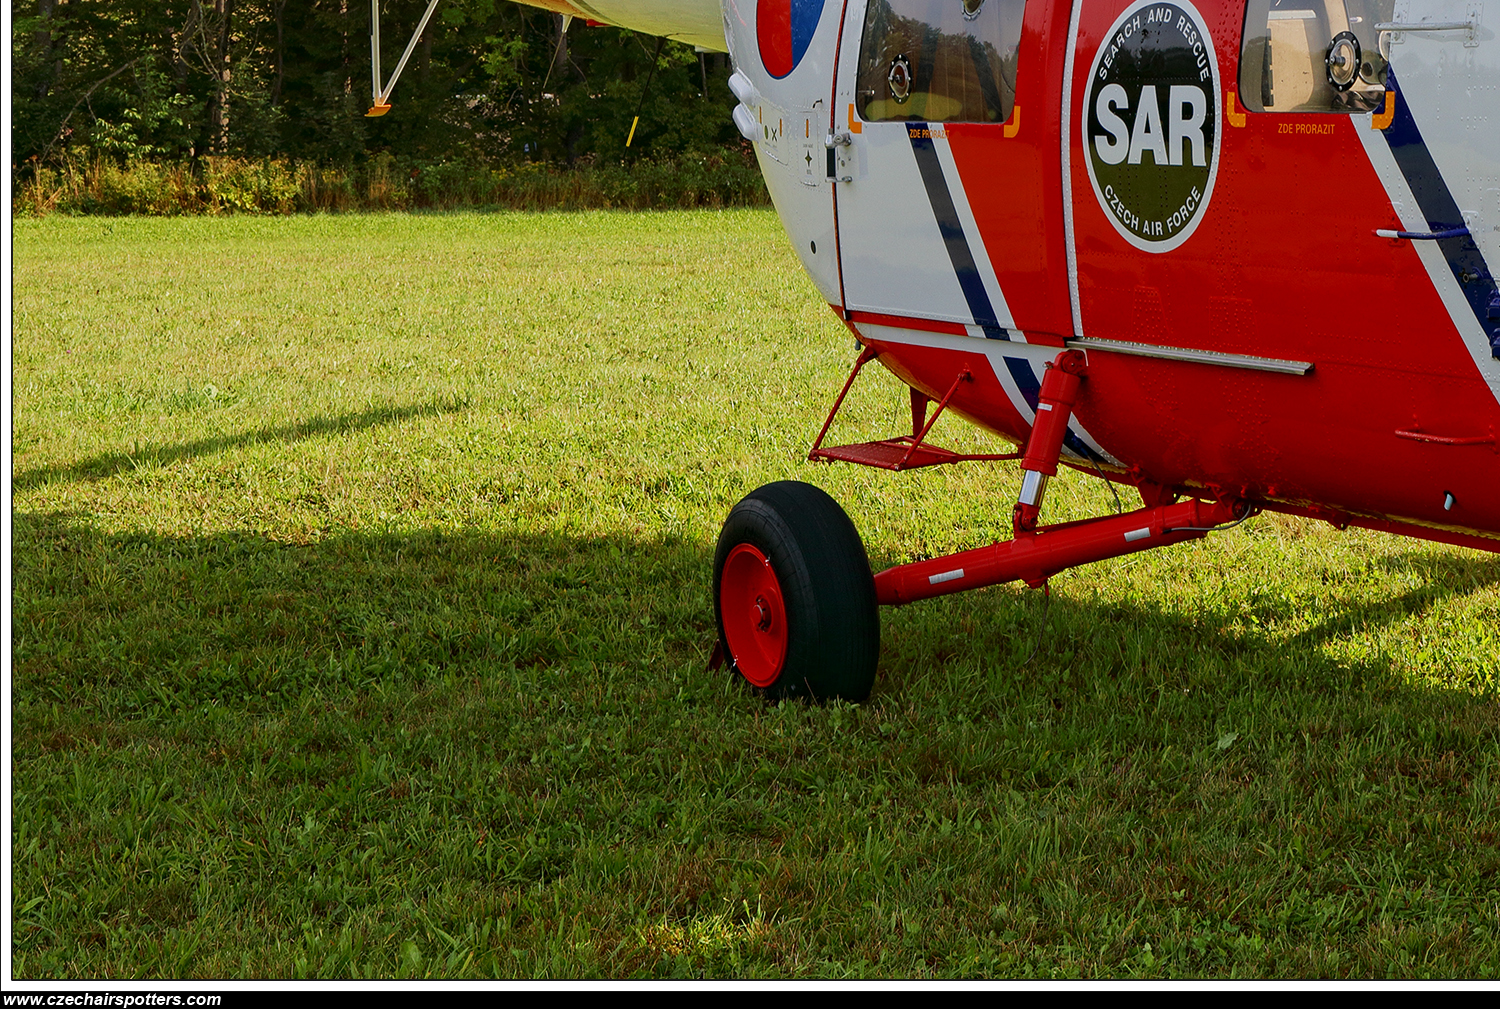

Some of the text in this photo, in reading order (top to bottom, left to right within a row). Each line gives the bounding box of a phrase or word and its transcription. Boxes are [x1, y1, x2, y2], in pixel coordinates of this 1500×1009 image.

[1098, 7, 1210, 82] SEARCH AND RESCUE
[909, 128, 921, 139] ZDE
[1094, 83, 1207, 167] SAR
[1278, 123, 1335, 135] ZDE PRORAZIT
[1104, 184, 1201, 236] CZECH AIR FORCE
